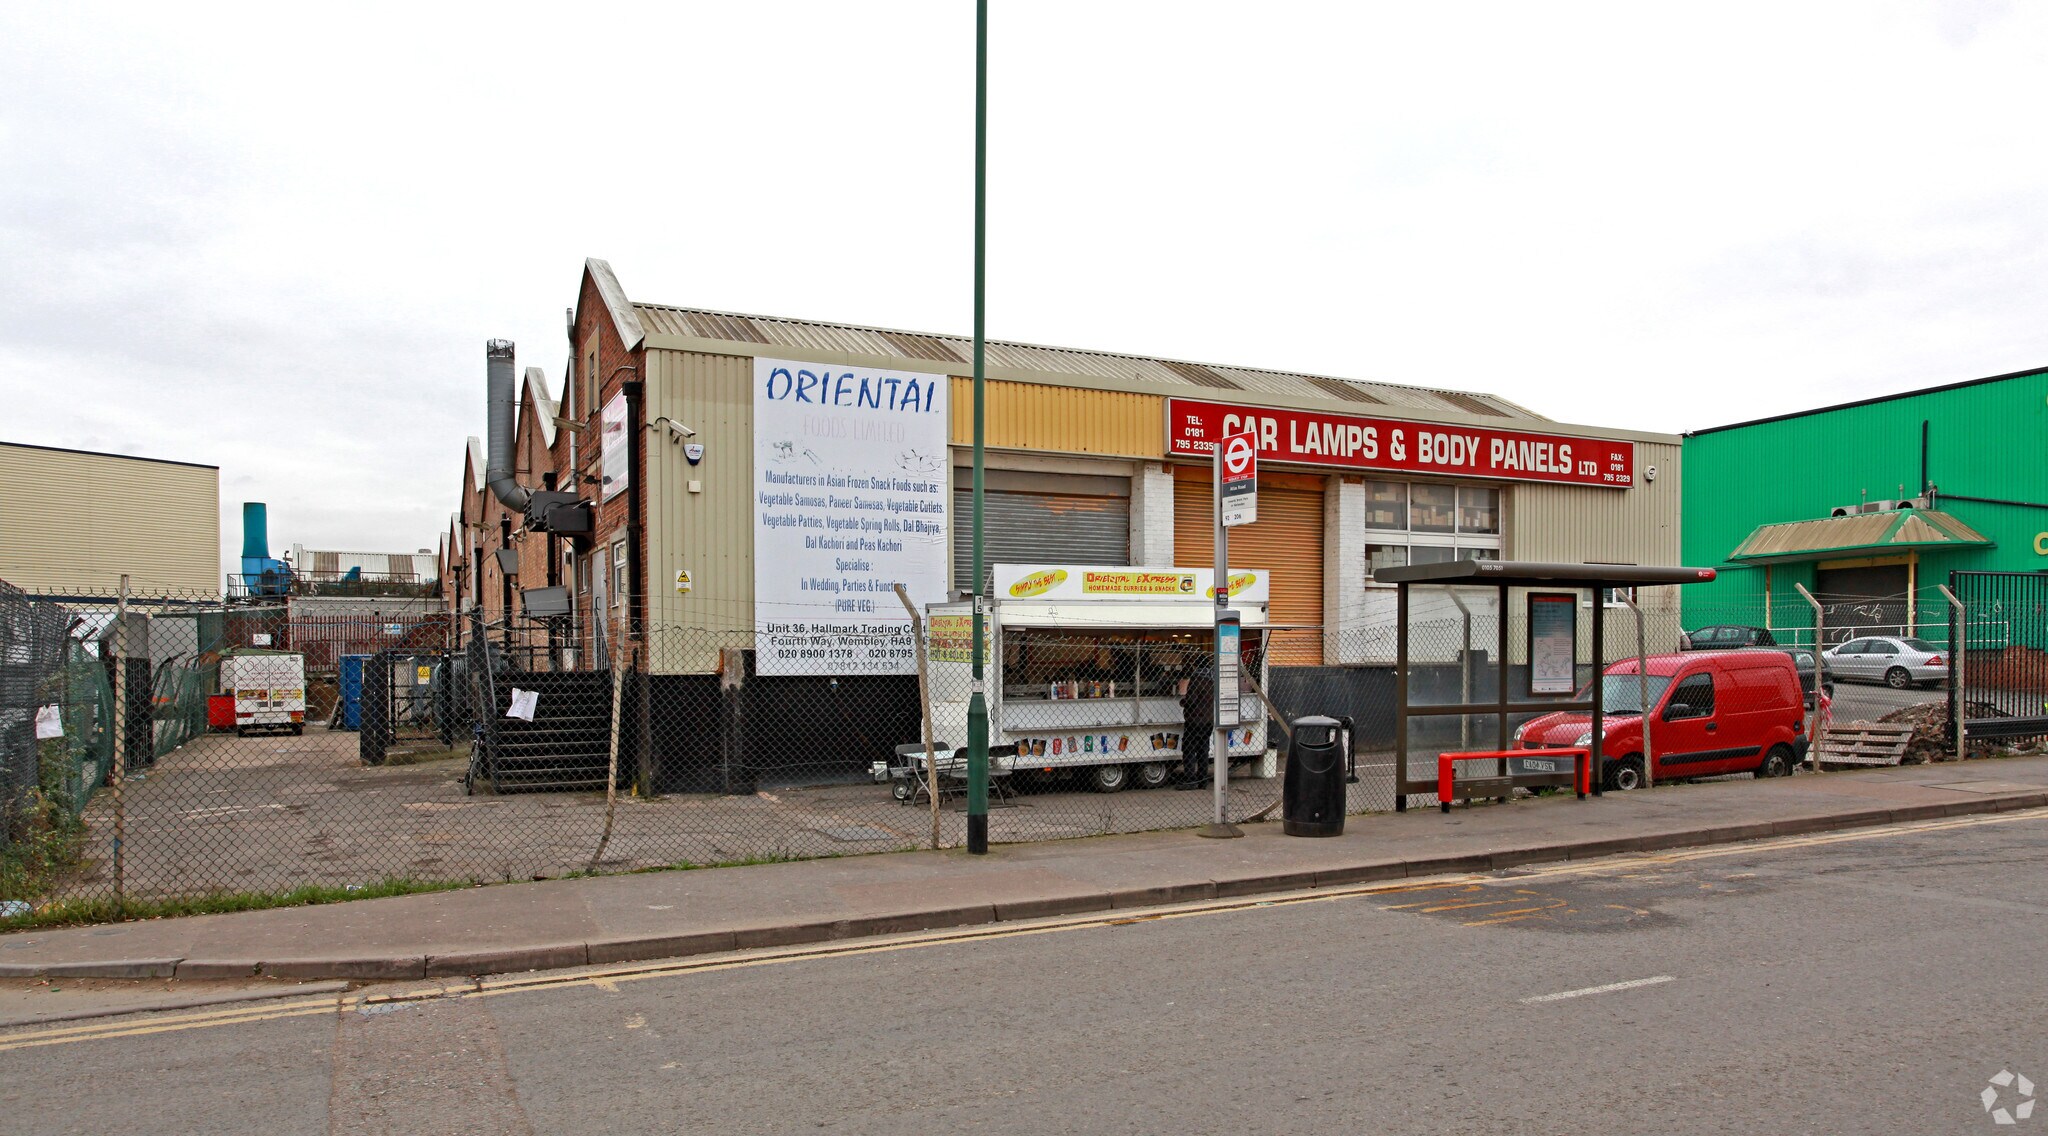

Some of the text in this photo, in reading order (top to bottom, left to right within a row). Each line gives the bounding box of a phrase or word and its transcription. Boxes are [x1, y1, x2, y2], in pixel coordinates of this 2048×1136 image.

[1186, 415, 1203, 426] TEL:
[1185, 427, 1204, 438] 0181
[1175, 439, 1214, 451] 795 2335
[1222, 413, 1598, 476] CAR LAMPS & BODY PANELS LTD
[765, 470, 817, 486] Manufacturers
[818, 474, 825, 486] in
[826, 474, 846, 488] Asian
[847, 475, 869, 489] Frozen
[870, 476, 890, 490] Snack
[892, 477, 912, 492] Foods
[912, 480, 928, 493] such
[759, 491, 794, 507] Vegetable
[829, 495, 852, 509] Paneer
[886, 498, 919, 514] Vegetable
[762, 513, 797, 529] Vegetable
[826, 516, 859, 531] Vegetable
[860, 517, 882, 533] Spring
[903, 519, 914, 532] Dal
[805, 535, 903, 552] Dal Kachori and Peas Kachori
[835, 557, 870, 573] Specialise
[801, 577, 808, 591] In
[842, 578, 867, 592] Parties
[868, 579, 874, 592] &
[767, 623, 790, 633] Unit
[792, 624, 808, 634] 36,
[811, 623, 859, 633] Hallmark
[861, 624, 901, 635] Trading
[771, 636, 807, 645] Fourth
[838, 637, 886, 647] Wembley,
[890, 637, 912, 645] HA9
[778, 649, 913, 658] 020 8900 1378 020 8795
